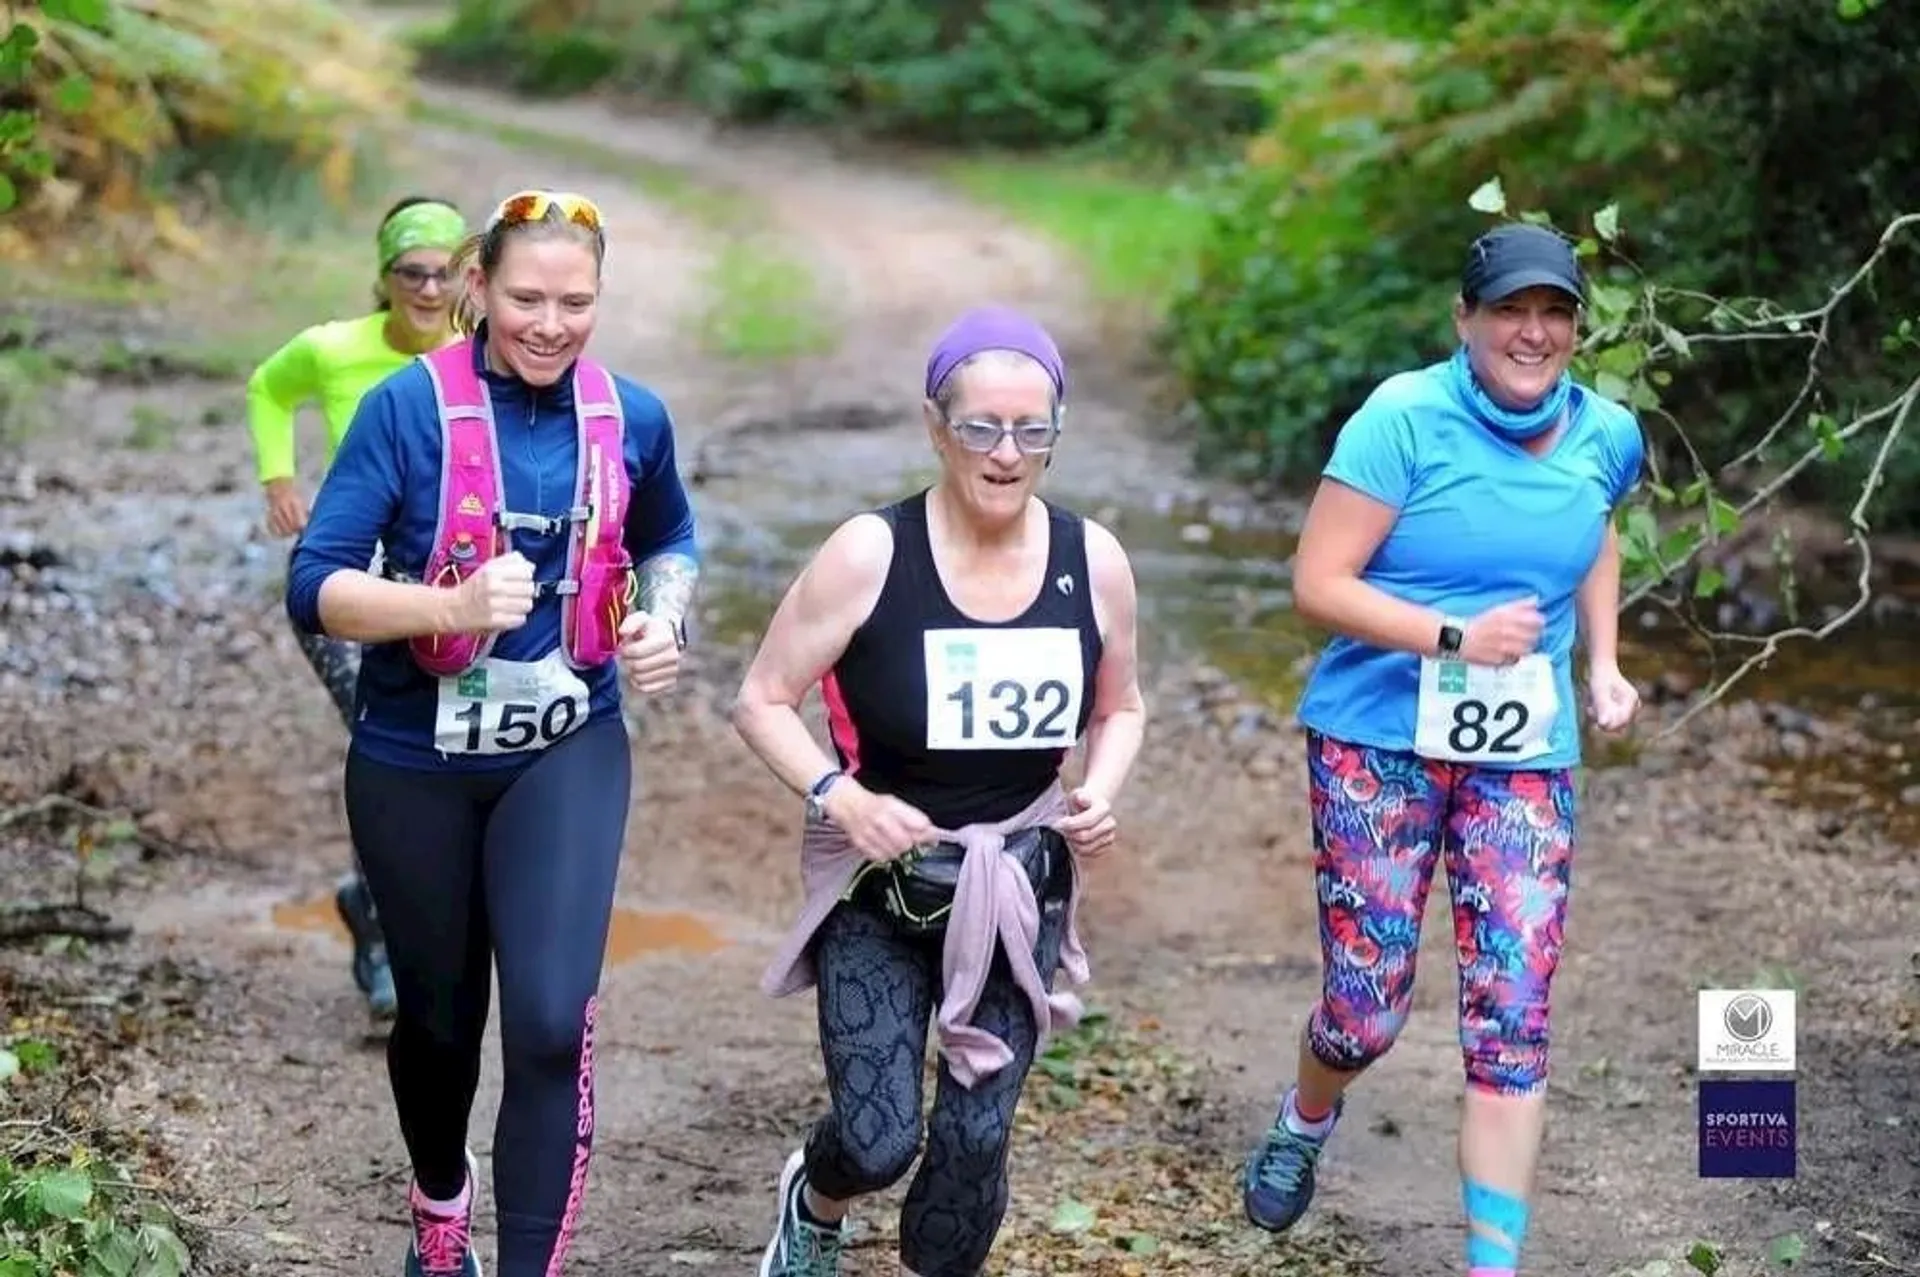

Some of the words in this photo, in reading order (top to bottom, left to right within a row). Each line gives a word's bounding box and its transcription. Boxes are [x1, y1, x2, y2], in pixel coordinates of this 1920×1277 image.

[455, 695, 577, 751] 150
[947, 679, 1070, 740] 132
[1449, 699, 1529, 754] 82
